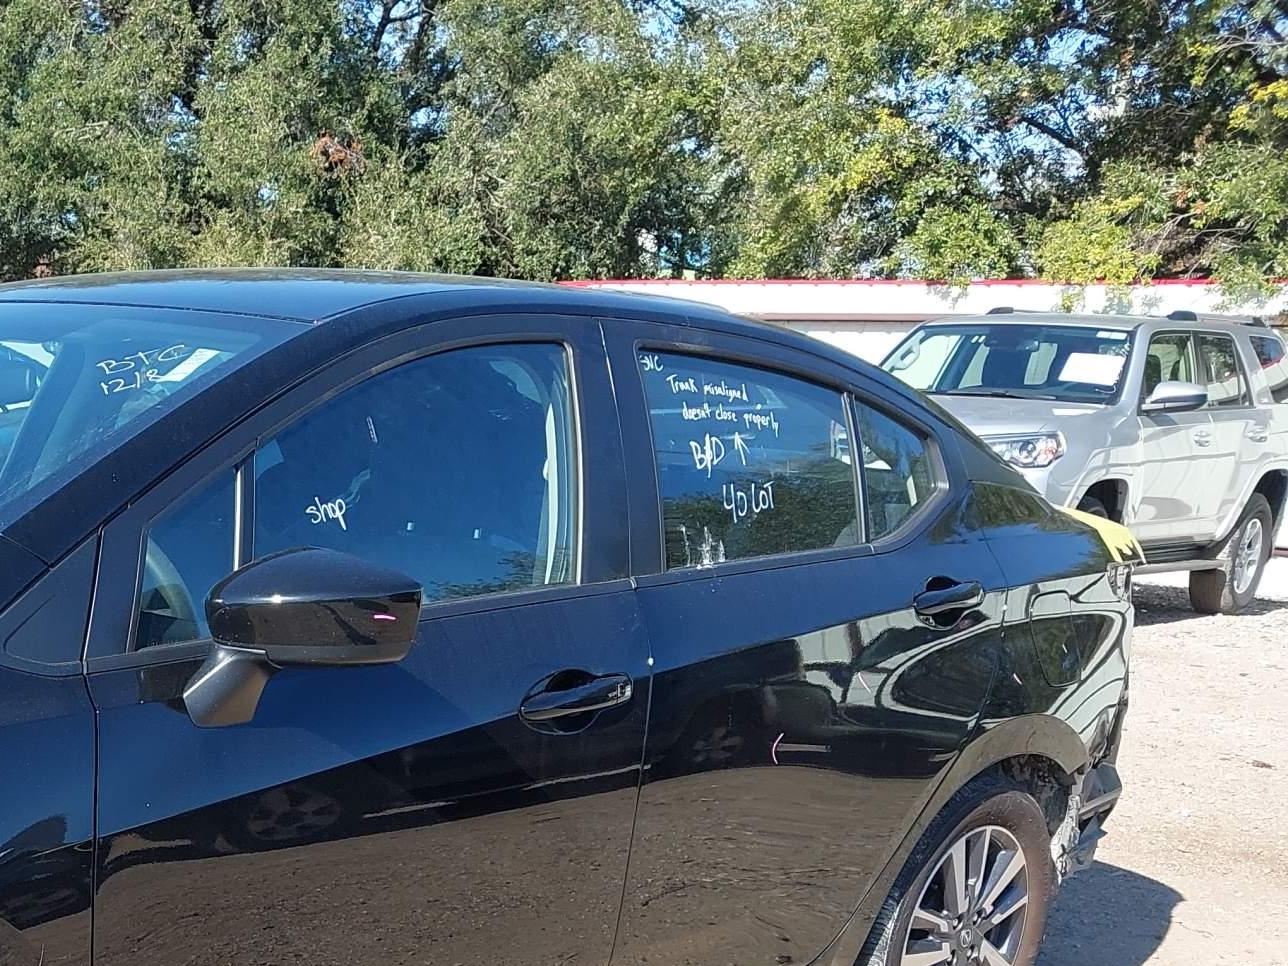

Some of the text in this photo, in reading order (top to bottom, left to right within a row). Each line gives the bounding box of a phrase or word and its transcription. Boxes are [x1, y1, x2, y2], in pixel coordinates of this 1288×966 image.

[98, 368, 163, 395] 12/8
[666, 374, 750, 403] Trunk misaligned
[715, 403, 738, 422] close
[743, 411, 780, 438] properly
[305, 496, 347, 530] shop
